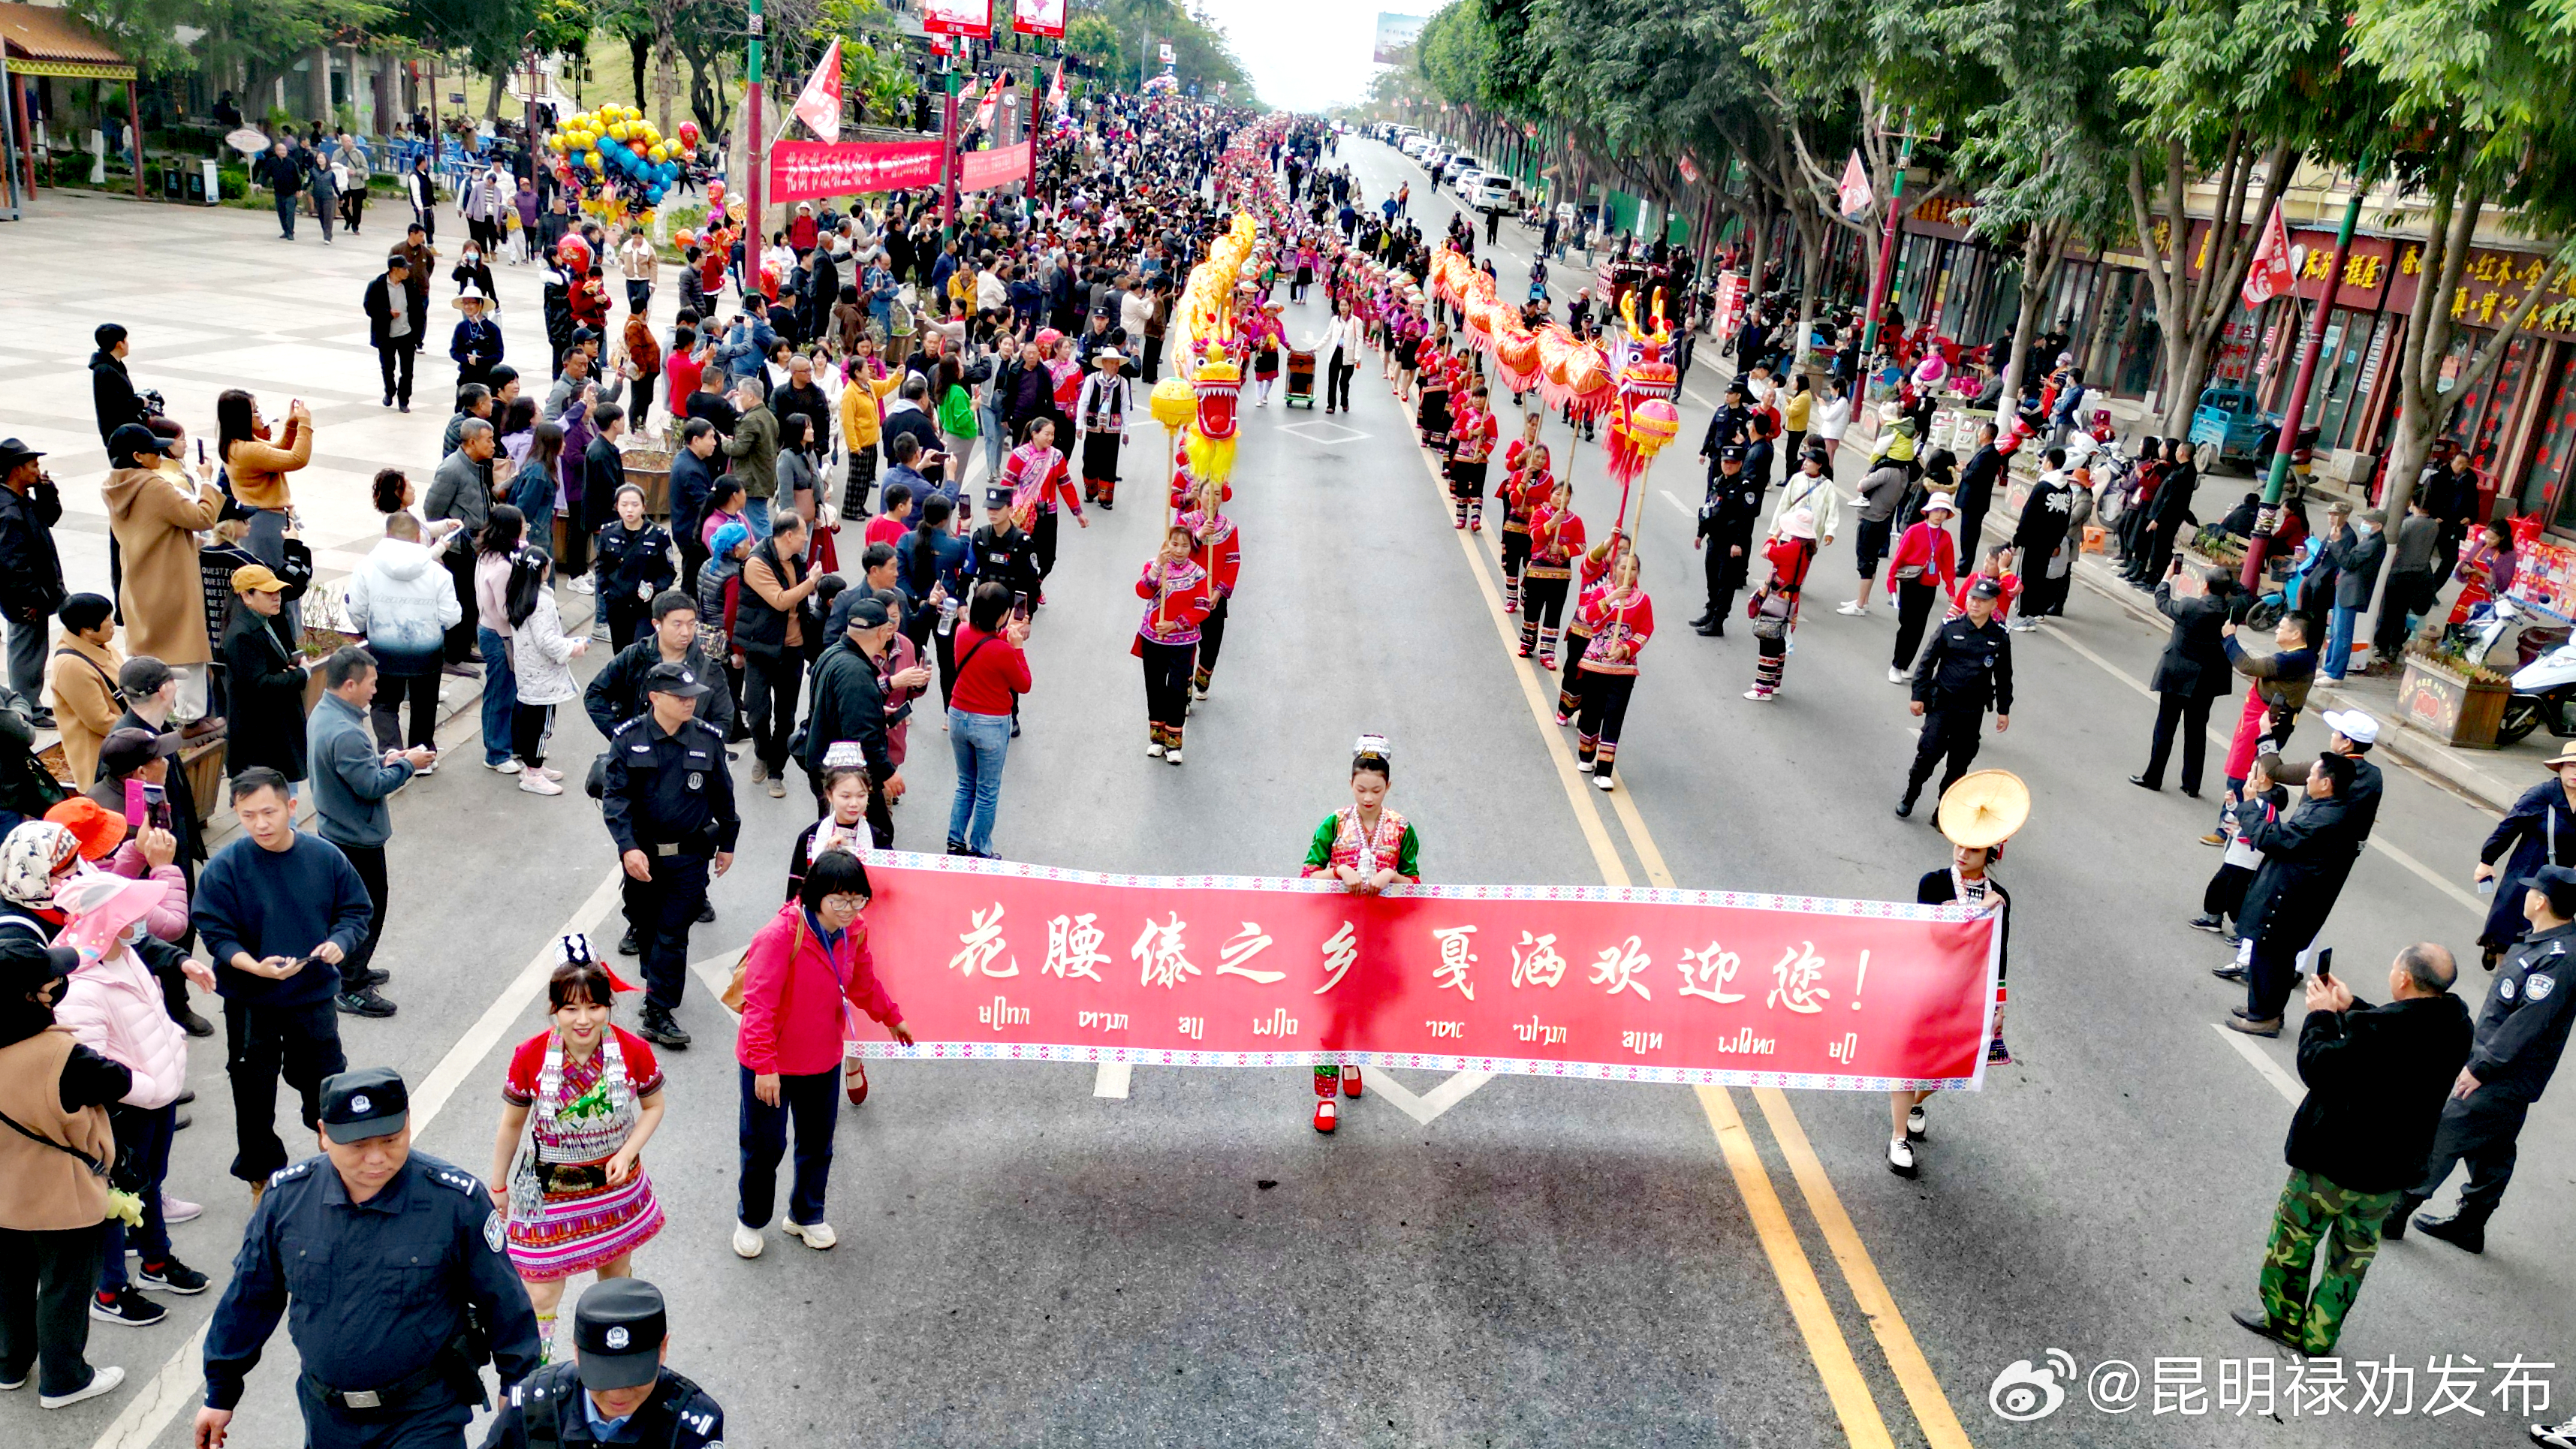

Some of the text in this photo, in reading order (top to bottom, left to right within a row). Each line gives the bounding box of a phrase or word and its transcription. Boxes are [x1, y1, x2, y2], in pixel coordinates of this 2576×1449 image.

[948, 901, 1360, 995] 花腰傣之乡
